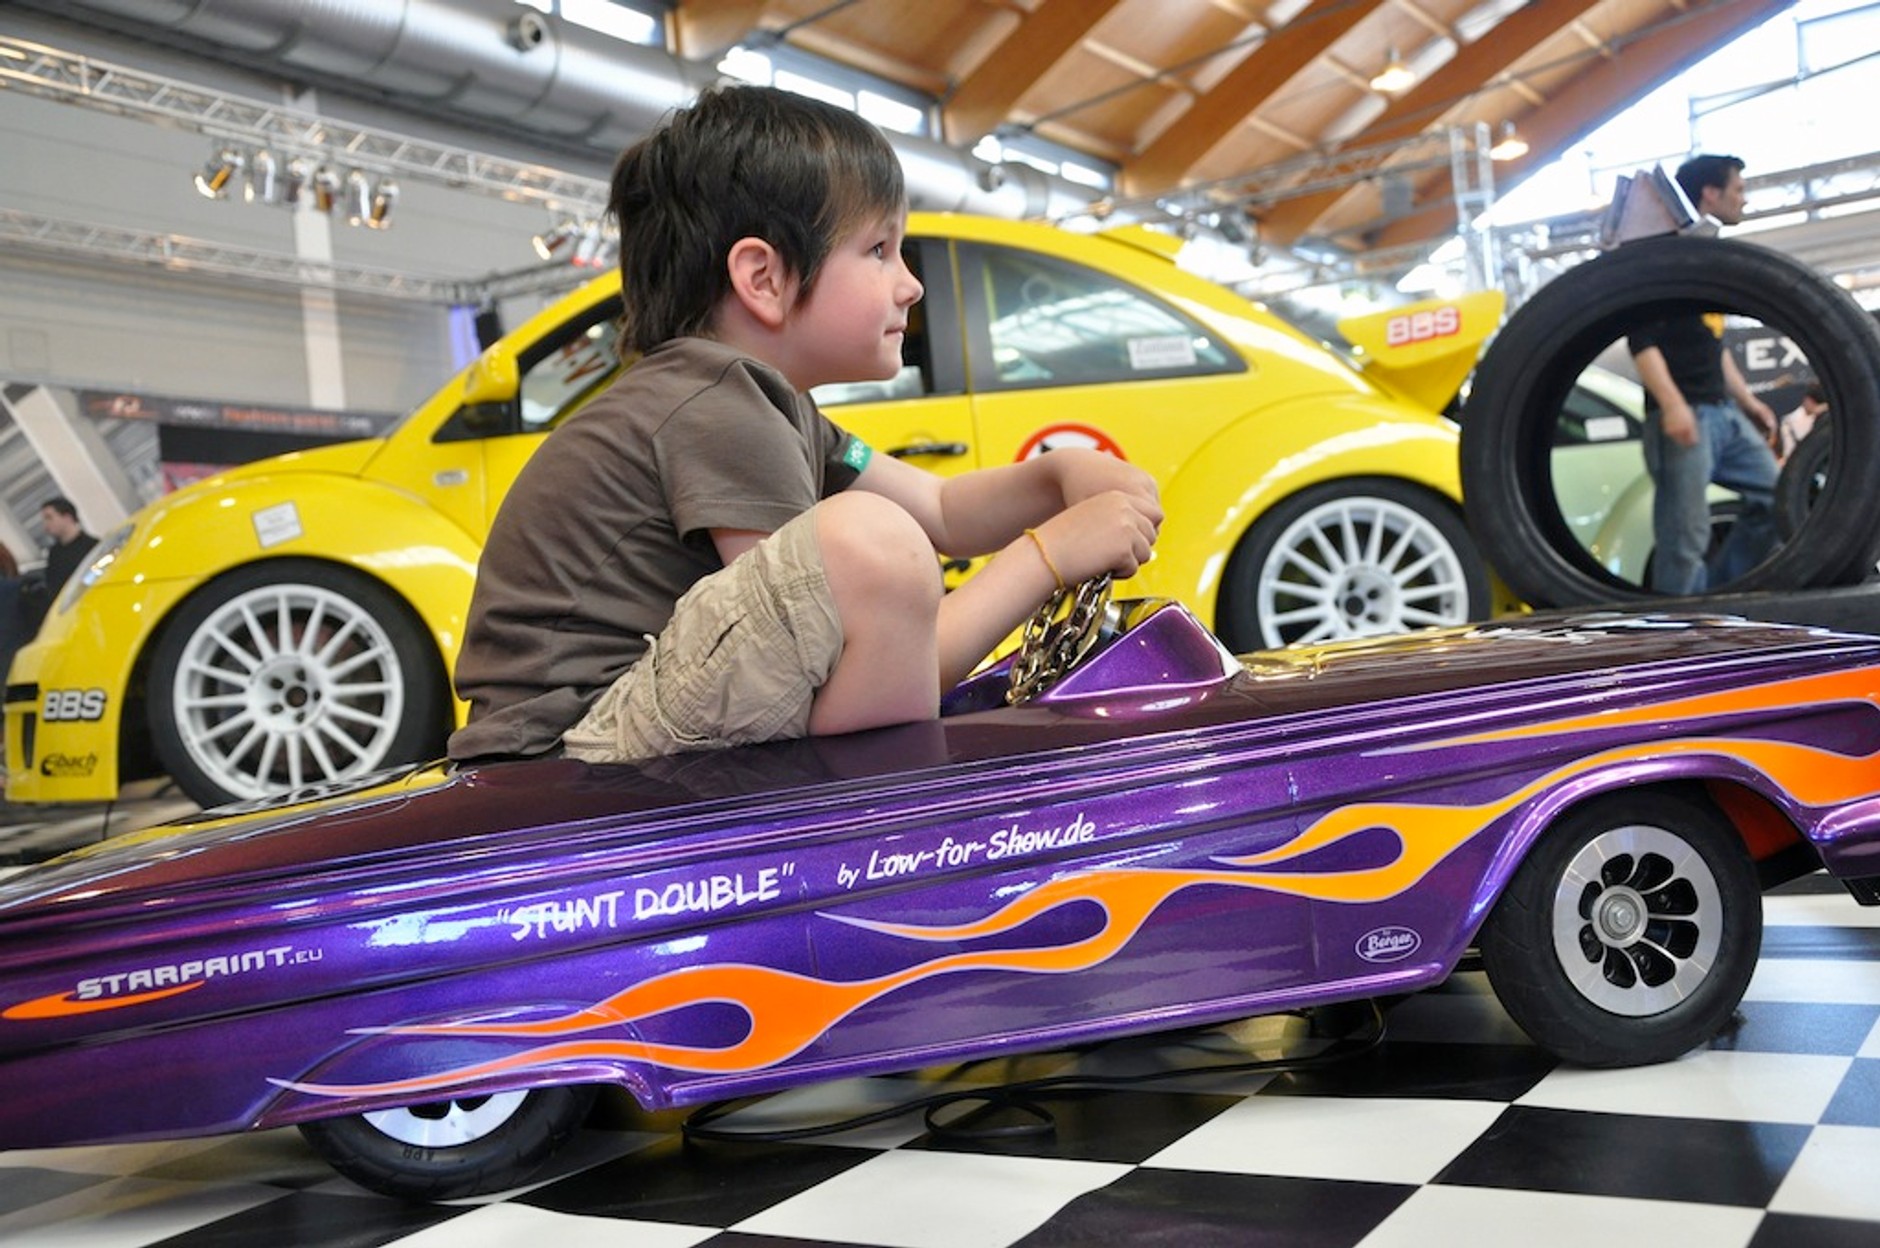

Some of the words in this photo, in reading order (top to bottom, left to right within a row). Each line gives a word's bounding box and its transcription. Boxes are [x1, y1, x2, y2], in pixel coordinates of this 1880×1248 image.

[1387, 306, 1460, 346] BBS
[43, 688, 106, 722] BBS
[837, 862, 860, 889] by
[866, 813, 1096, 881] Low-for-Show.de
[632, 862, 796, 920] DOUBLE"
